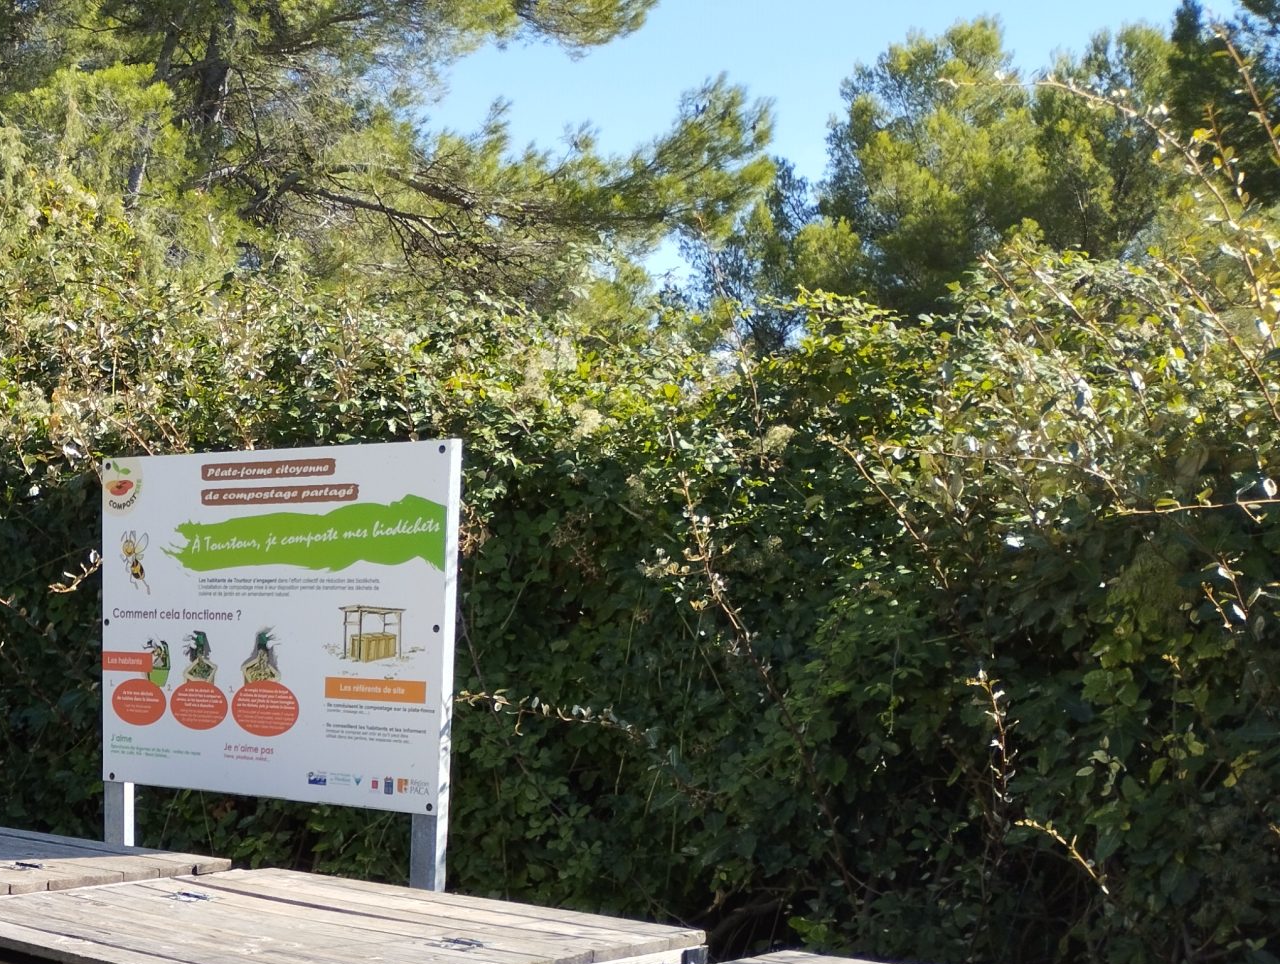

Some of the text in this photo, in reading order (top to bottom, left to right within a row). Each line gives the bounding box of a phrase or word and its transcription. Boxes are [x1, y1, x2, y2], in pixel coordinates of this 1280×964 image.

[207, 464, 329, 477] Plate-forme citoyenne
[205, 485, 354, 500] de compostage partagé
[109, 493, 137, 510] COMPOST
[191, 534, 201, 554] À
[265, 532, 277, 552] je
[281, 528, 337, 548] composte
[342, 529, 368, 539] mes
[373, 516, 440, 538] biodéchets
[112, 608, 242, 621] Comment cela fonctionne ?
[339, 684, 351, 692] Les
[353, 685, 381, 694] référents
[392, 687, 405, 695] site
[224, 743, 275, 756] Je n'aime pas
[410, 786, 430, 796] PACA
